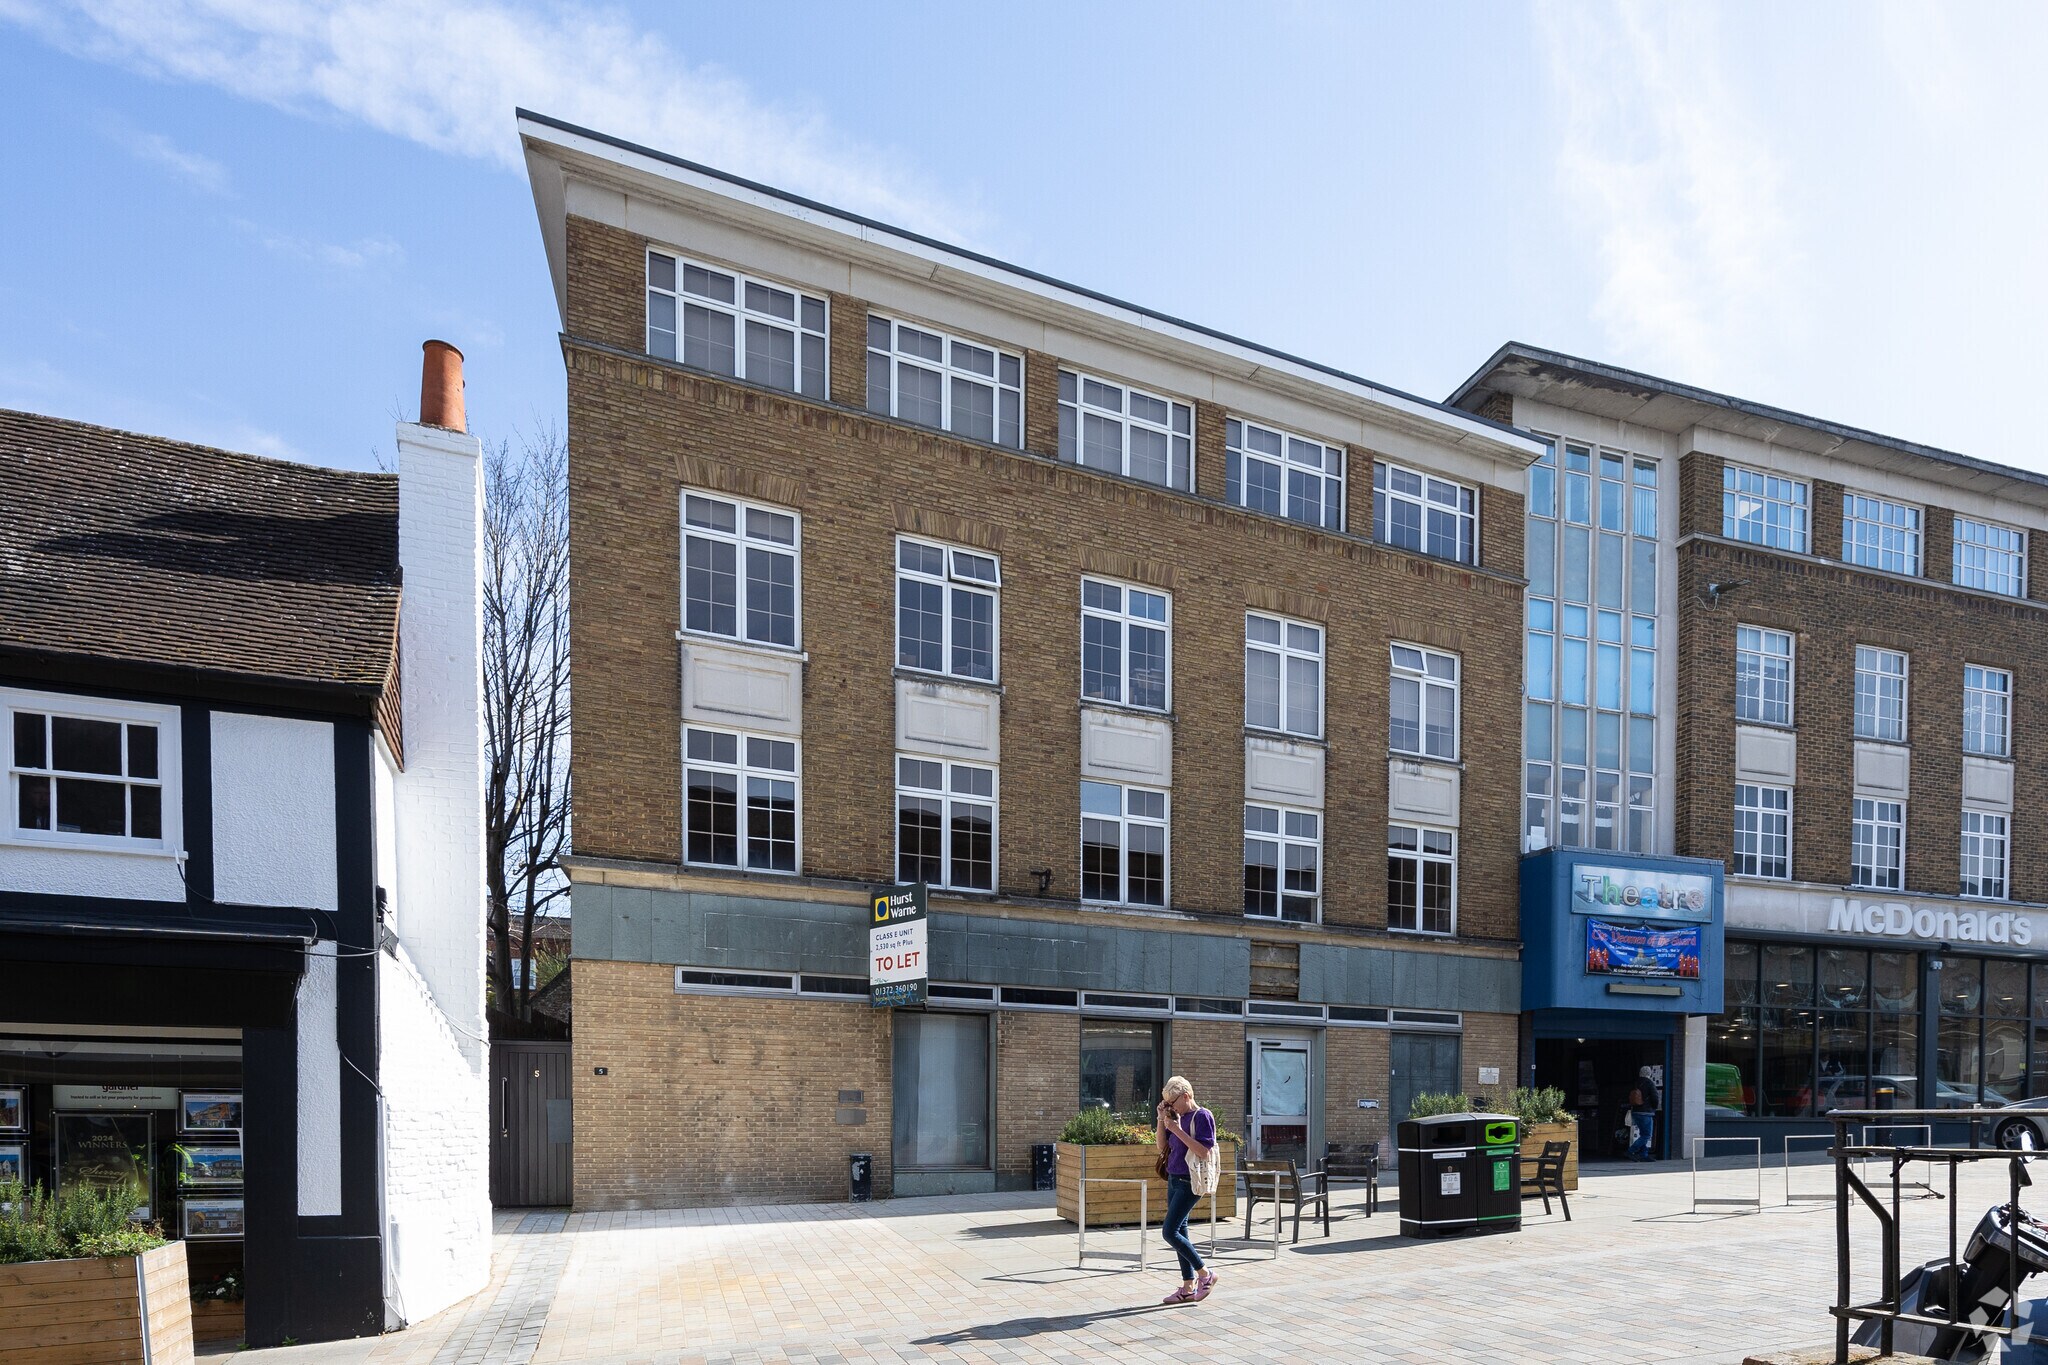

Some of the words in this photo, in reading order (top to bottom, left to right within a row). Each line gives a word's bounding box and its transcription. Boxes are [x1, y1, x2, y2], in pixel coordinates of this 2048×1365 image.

[890, 891, 913, 906] Hurst
[1581, 874, 1705, 912] Theatre
[890, 904, 917, 919] Warne
[1827, 898, 2032, 945] McDonald's
[875, 931, 893, 941] CLASS
[899, 928, 913, 937] UNIT
[875, 955, 893, 972] TO
[897, 951, 920, 969] LET
[875, 985, 894, 996] 01372
[78, 1141, 128, 1149] WINNERS
